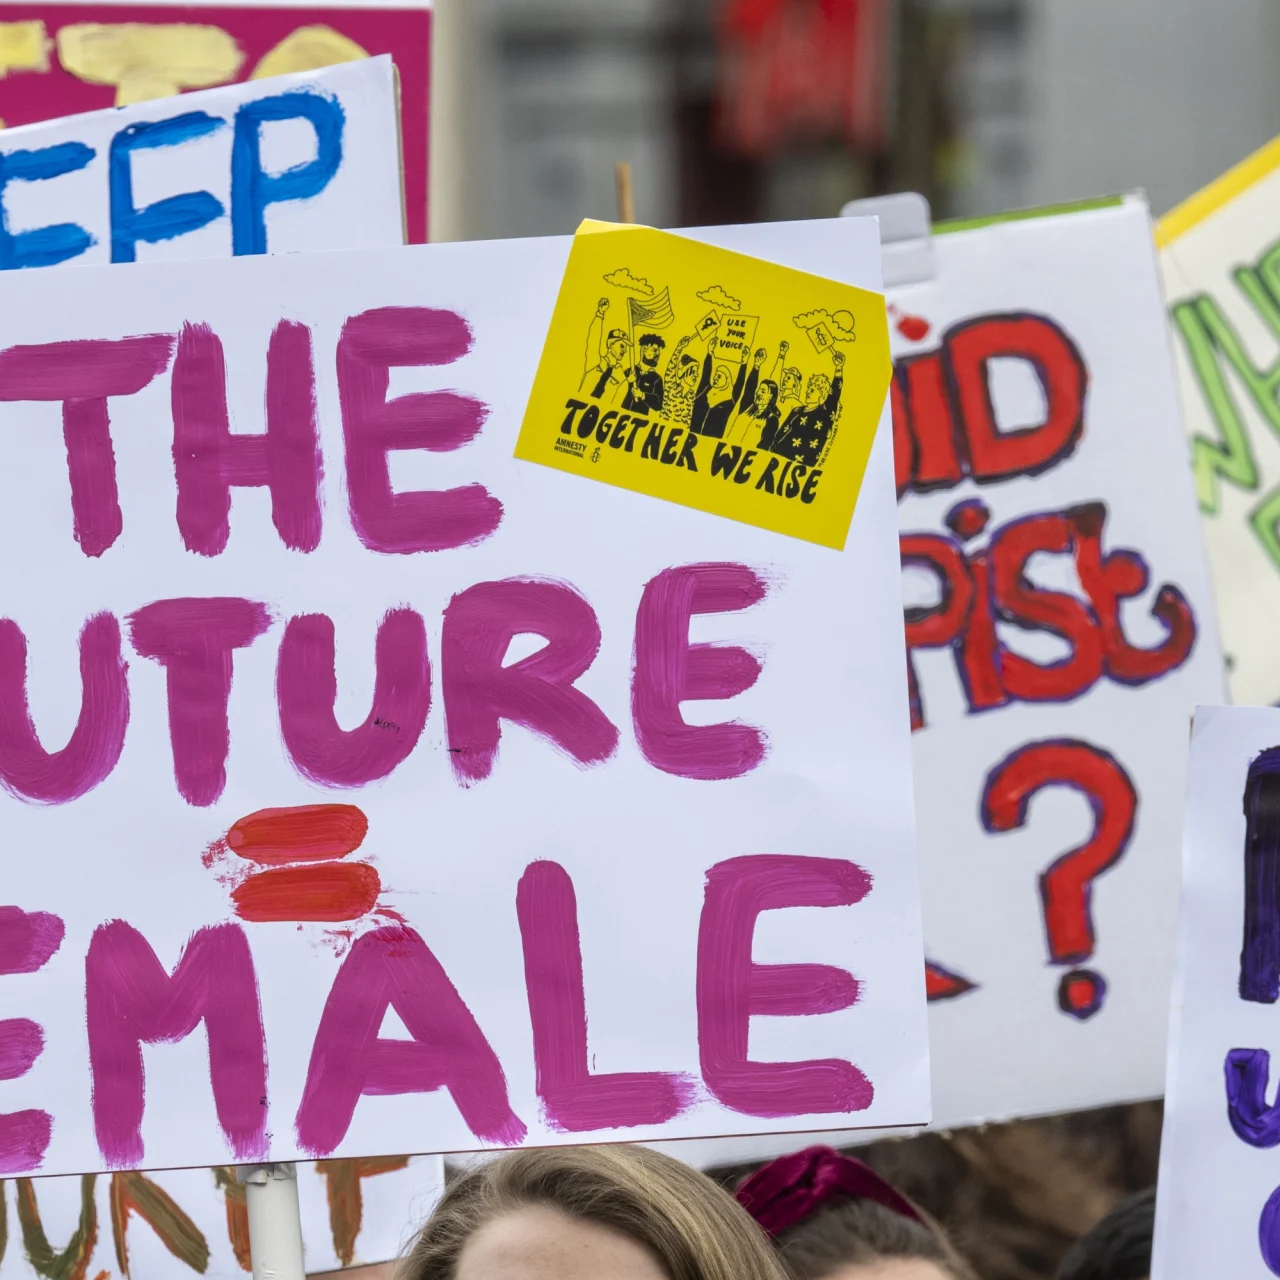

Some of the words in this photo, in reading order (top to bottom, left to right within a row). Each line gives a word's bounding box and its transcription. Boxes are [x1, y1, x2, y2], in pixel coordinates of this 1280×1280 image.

[726, 318, 747, 328] USE
[726, 328, 746, 340] YOUR
[719, 339, 744, 350] VOICE
[555, 437, 588, 453] AMNESTY
[560, 398, 699, 473] TOGETHER
[710, 441, 758, 485] WE
[754, 456, 823, 505] RISE
[980, 738, 1138, 1020] ?
